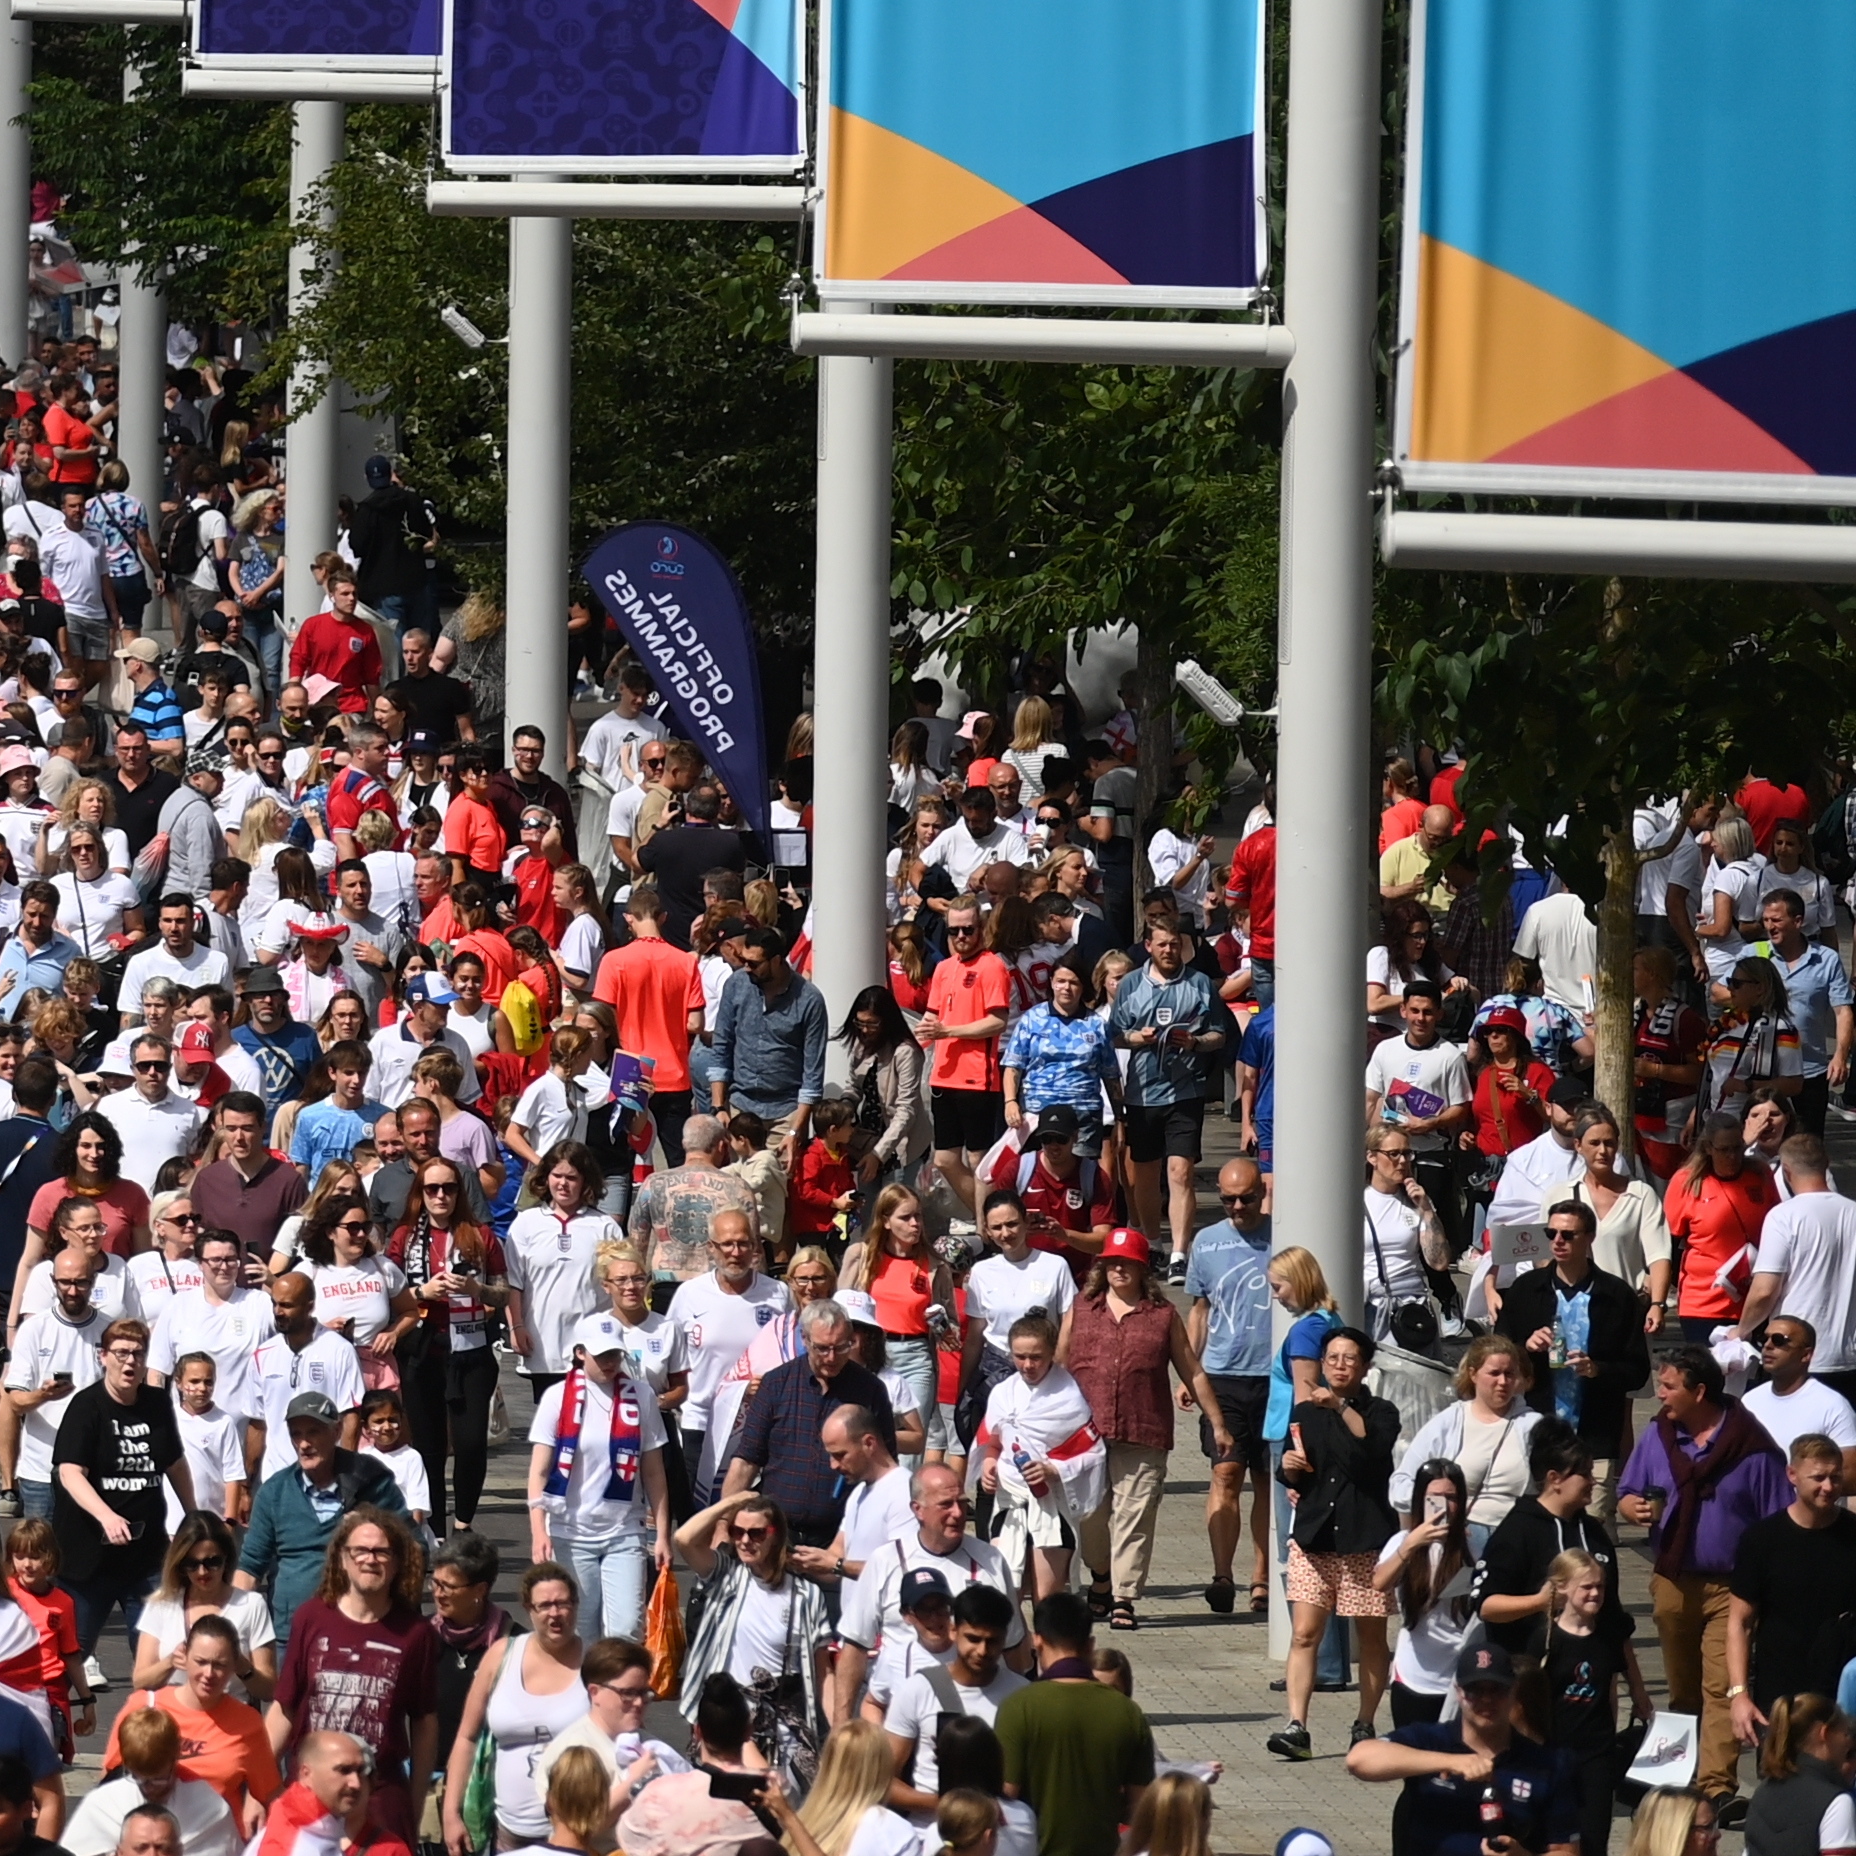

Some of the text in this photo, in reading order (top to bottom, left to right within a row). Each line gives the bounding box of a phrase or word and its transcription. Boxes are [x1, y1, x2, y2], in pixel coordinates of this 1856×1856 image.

[666, 1172, 724, 1192] ENGLAND
[322, 1279, 382, 1299] ENGLAND
[123, 1421, 151, 1439] am
[119, 1439, 151, 1455] the
[117, 1457, 156, 1473] 12th
[101, 1475, 161, 1491] woman
